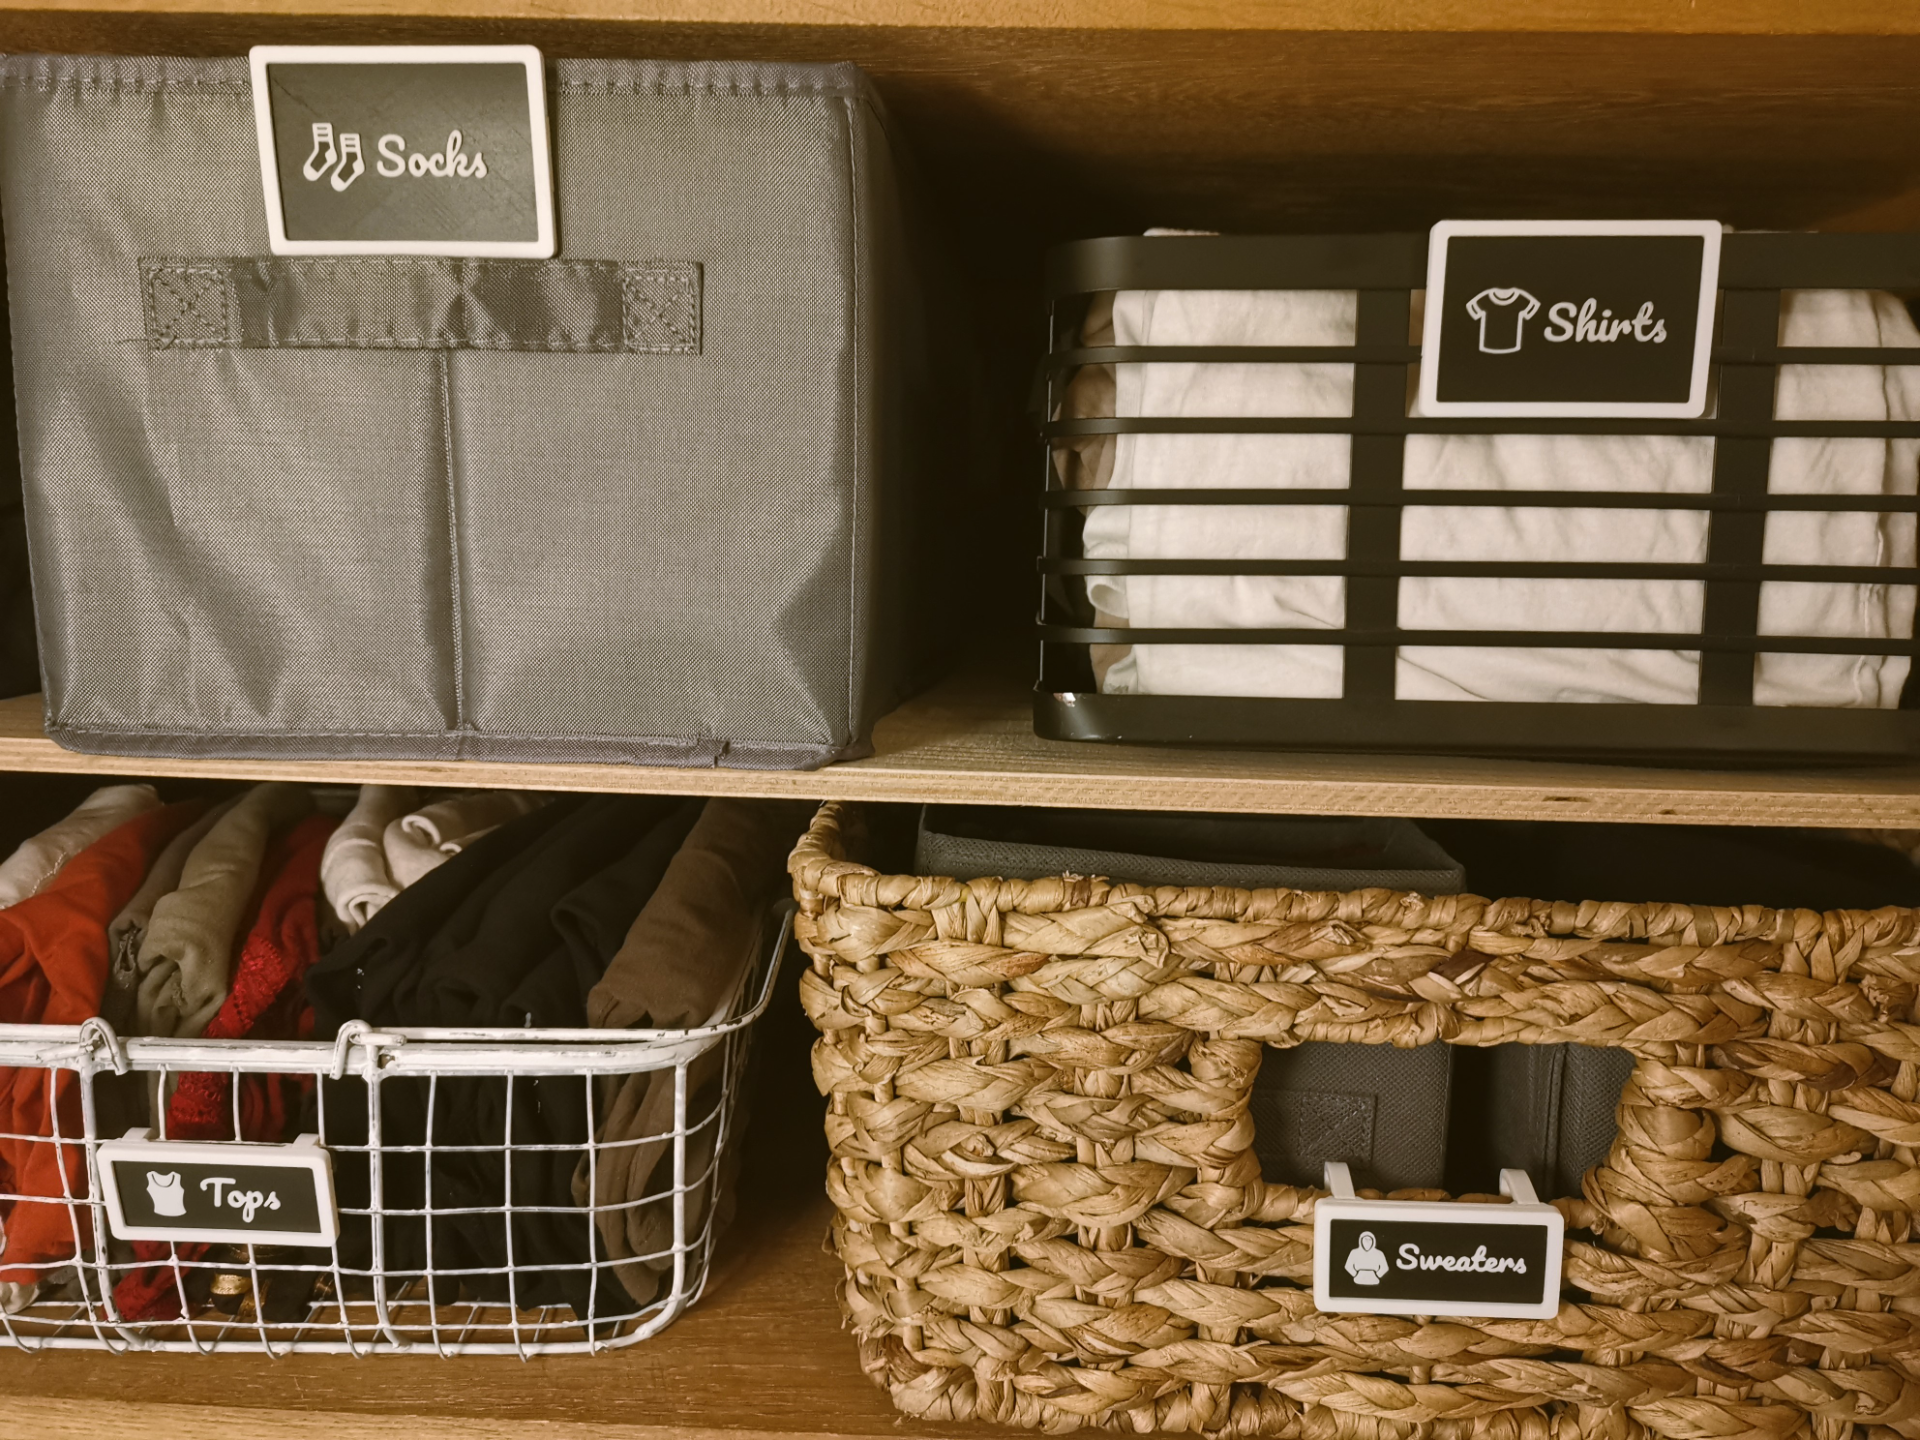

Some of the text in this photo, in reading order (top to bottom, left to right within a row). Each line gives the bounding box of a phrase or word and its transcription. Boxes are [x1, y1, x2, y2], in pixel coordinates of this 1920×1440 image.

[375, 129, 488, 180] Socks
[1543, 297, 1668, 345] Shirts
[199, 1176, 282, 1225] Tops
[1395, 1242, 1528, 1275] Sweaters
